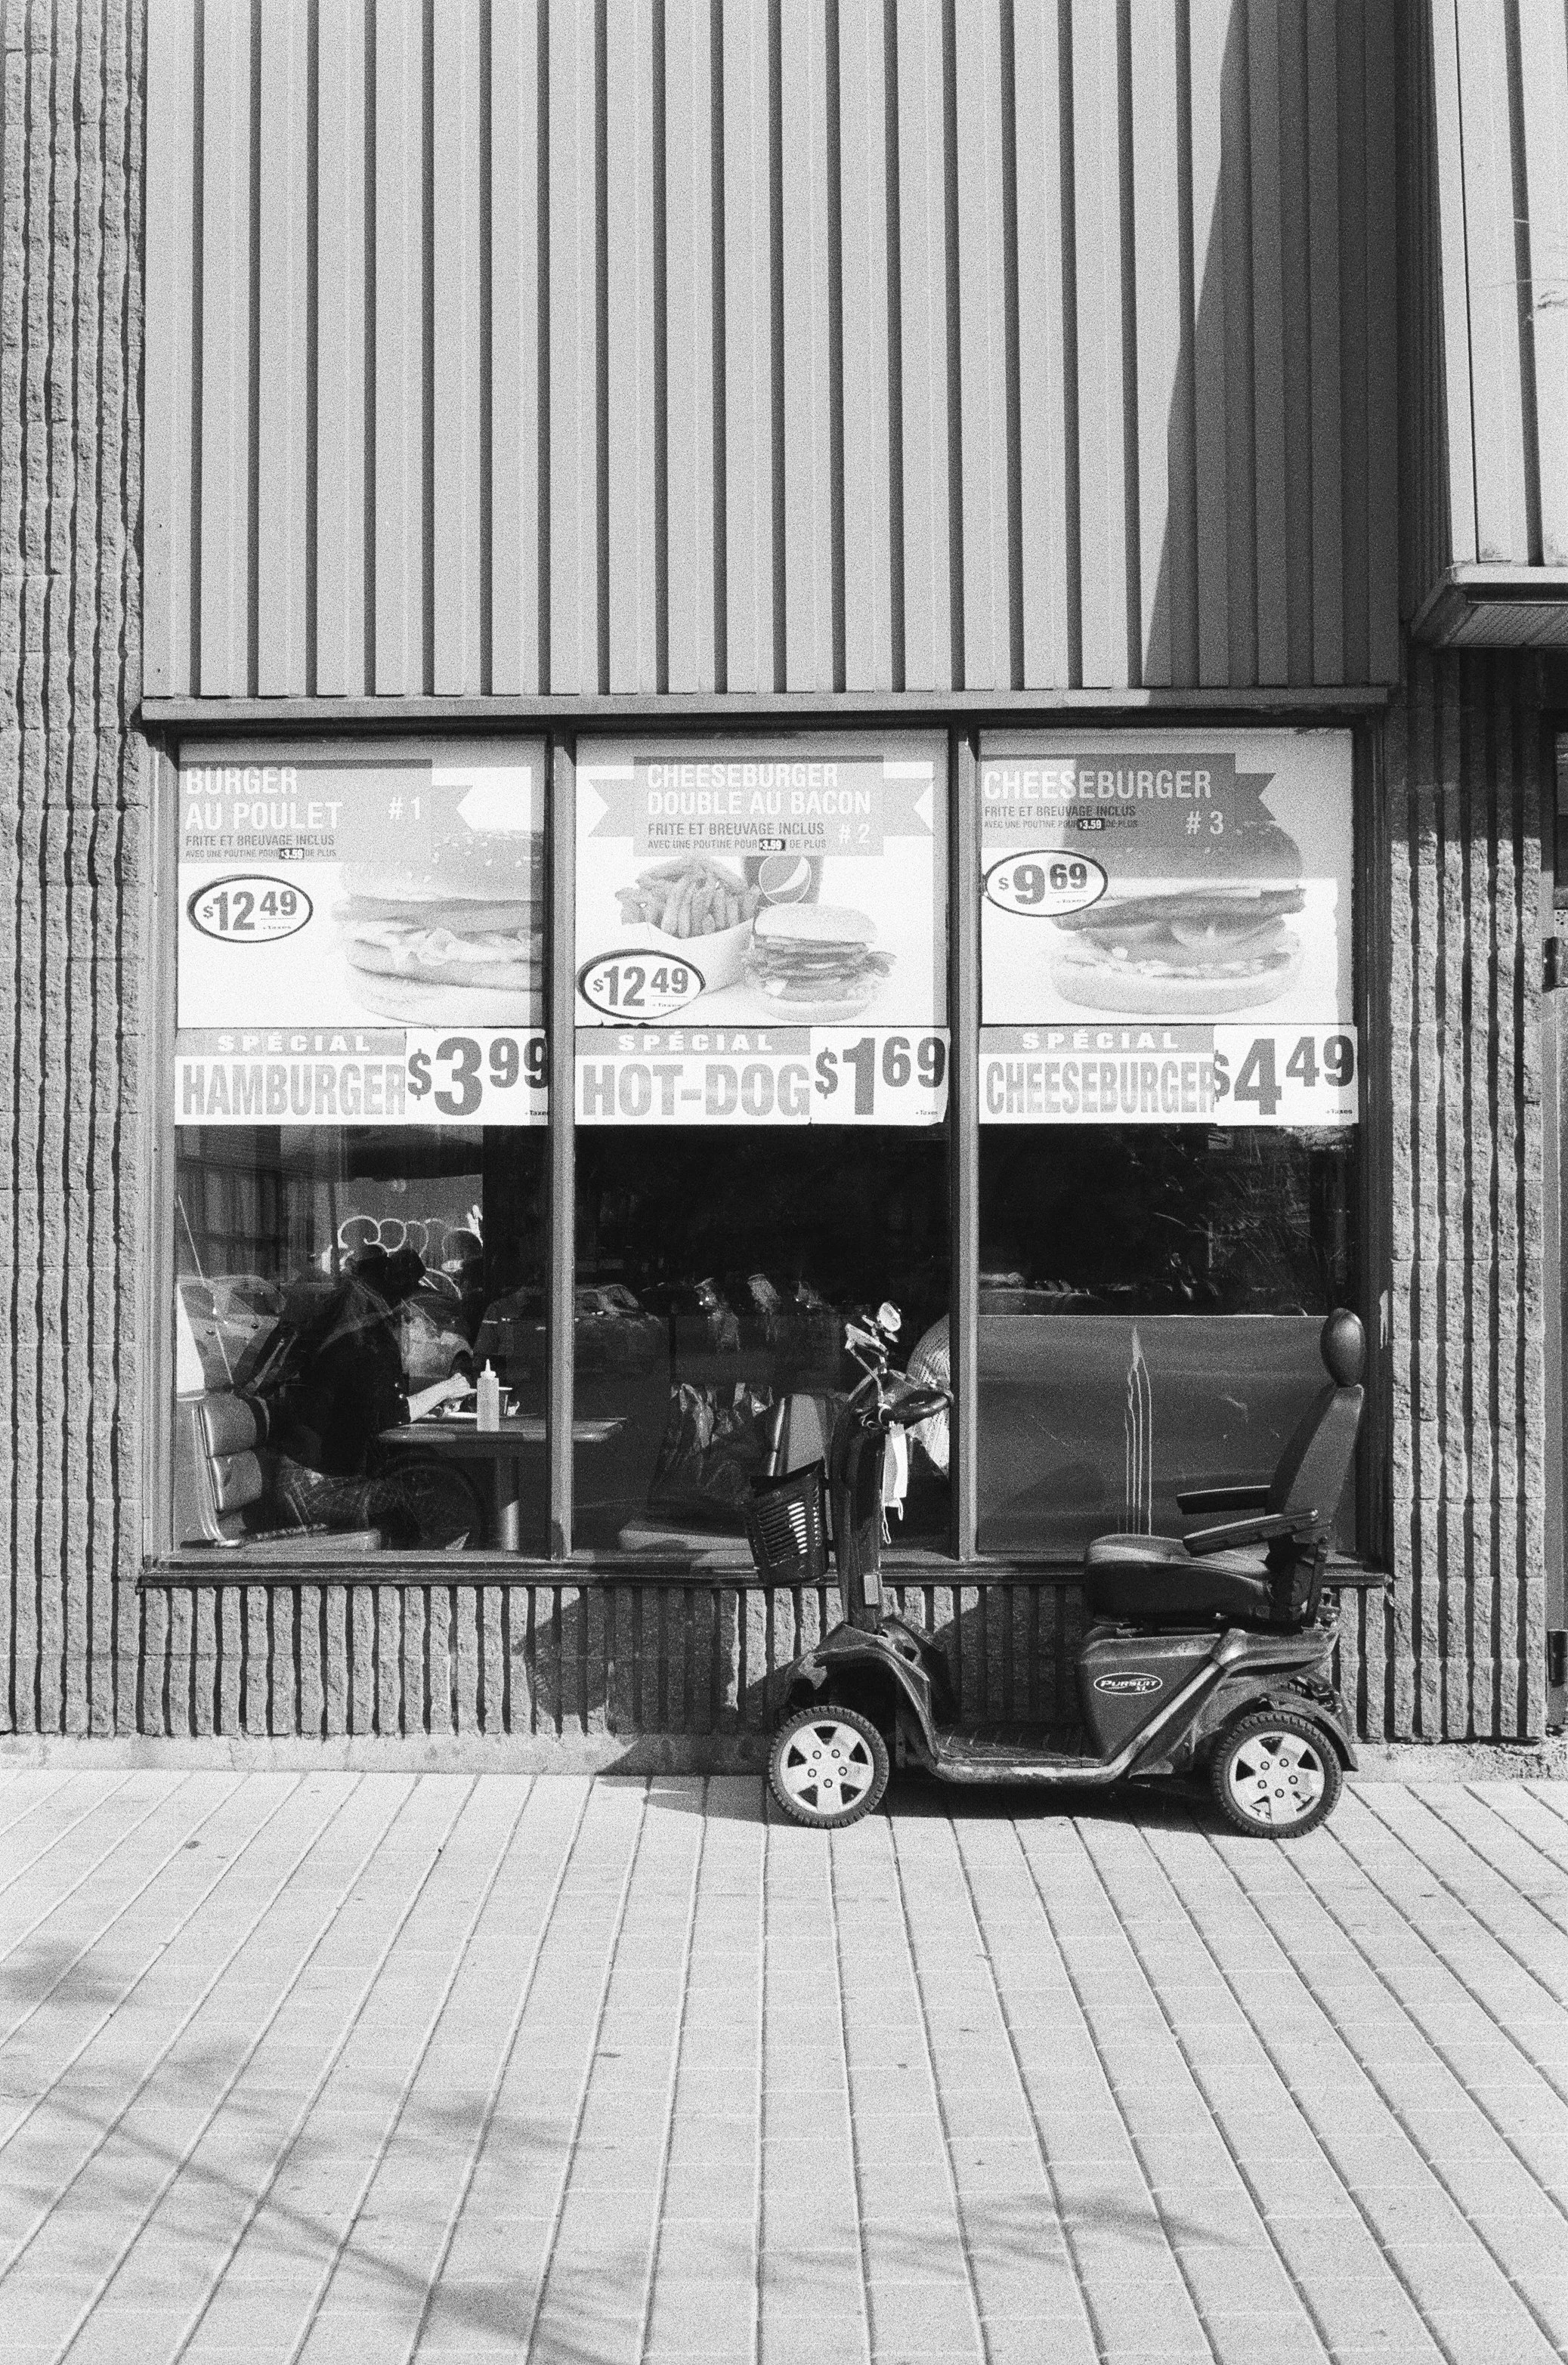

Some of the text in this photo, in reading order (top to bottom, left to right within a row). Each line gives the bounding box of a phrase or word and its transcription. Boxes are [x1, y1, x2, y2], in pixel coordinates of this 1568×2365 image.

[186, 767, 297, 793] BURGER
[648, 764, 838, 788] CHEESEBURGER
[984, 770, 1211, 799] CHEESEBURGER
[648, 790, 871, 815] DOUBLE AU BACON
[985, 805, 1136, 816] FRITE ET BREUVAGE INCLUS
[185, 801, 343, 830] AU POULET
[648, 822, 824, 835] FRITE ET BREUVAGE INCLUS
[186, 834, 335, 846] FRITE ET BREUVAGE INCLUS
[648, 839, 670, 849] AVEC
[673, 839, 690, 849] UNE
[694, 839, 731, 849] POUTINE
[735, 839, 757, 849] POUR
[790, 839, 801, 849] DE
[804, 839, 827, 848] PLUS
[186, 849, 204, 858] AVEC
[207, 849, 221, 858] UNE
[224, 849, 256, 858] POUTINE
[305, 849, 315, 857] DE
[318, 849, 336, 857] PLUS
[218, 1032, 370, 1052] SPÉCIAL
[618, 1031, 772, 1051] SPÉCIAL
[1022, 1029, 1178, 1049] SPÉCIAL
[183, 1064, 405, 1116] HAMBURGER
[583, 1064, 810, 1116] HOT-DOG
[986, 1061, 1214, 1114] CHEESEBURGER
[1100, 1679, 1158, 1687] PURSUIT
